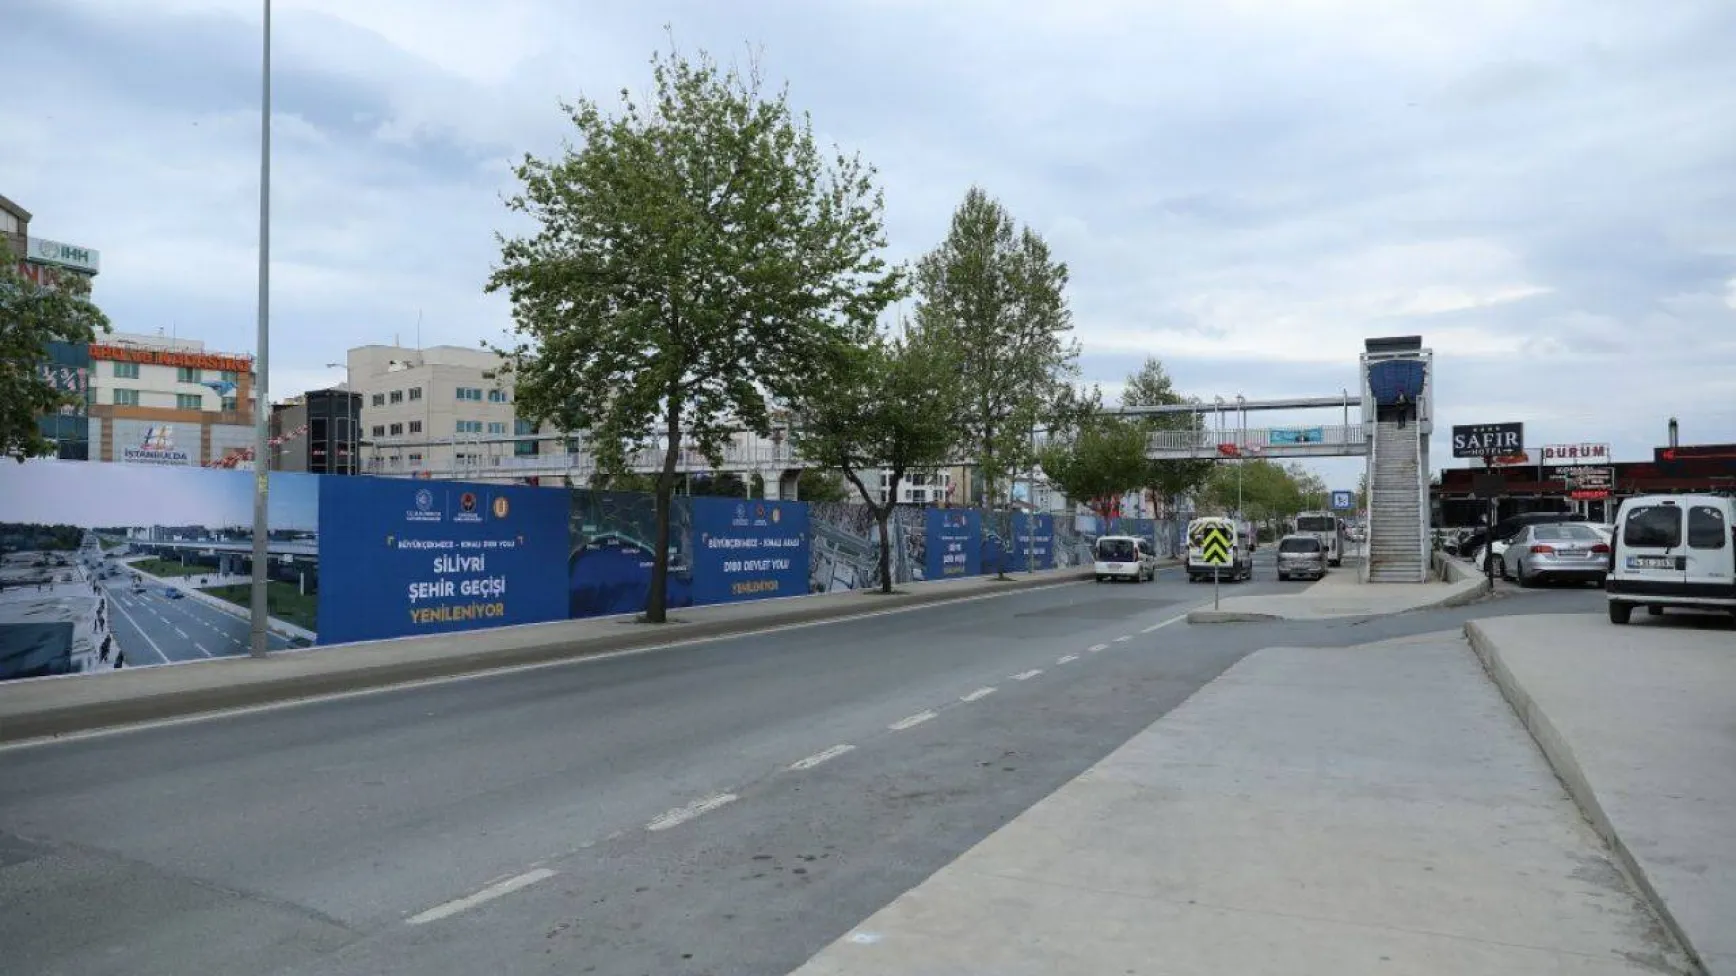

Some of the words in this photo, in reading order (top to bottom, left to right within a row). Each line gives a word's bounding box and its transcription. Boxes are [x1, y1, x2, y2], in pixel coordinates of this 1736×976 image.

[433, 554, 485, 573] SİLİVRİ
[408, 578, 455, 603] ŞEHİR
[460, 575, 506, 598] GEÇİŞİ
[410, 600, 504, 623] YENİLENİYOR
